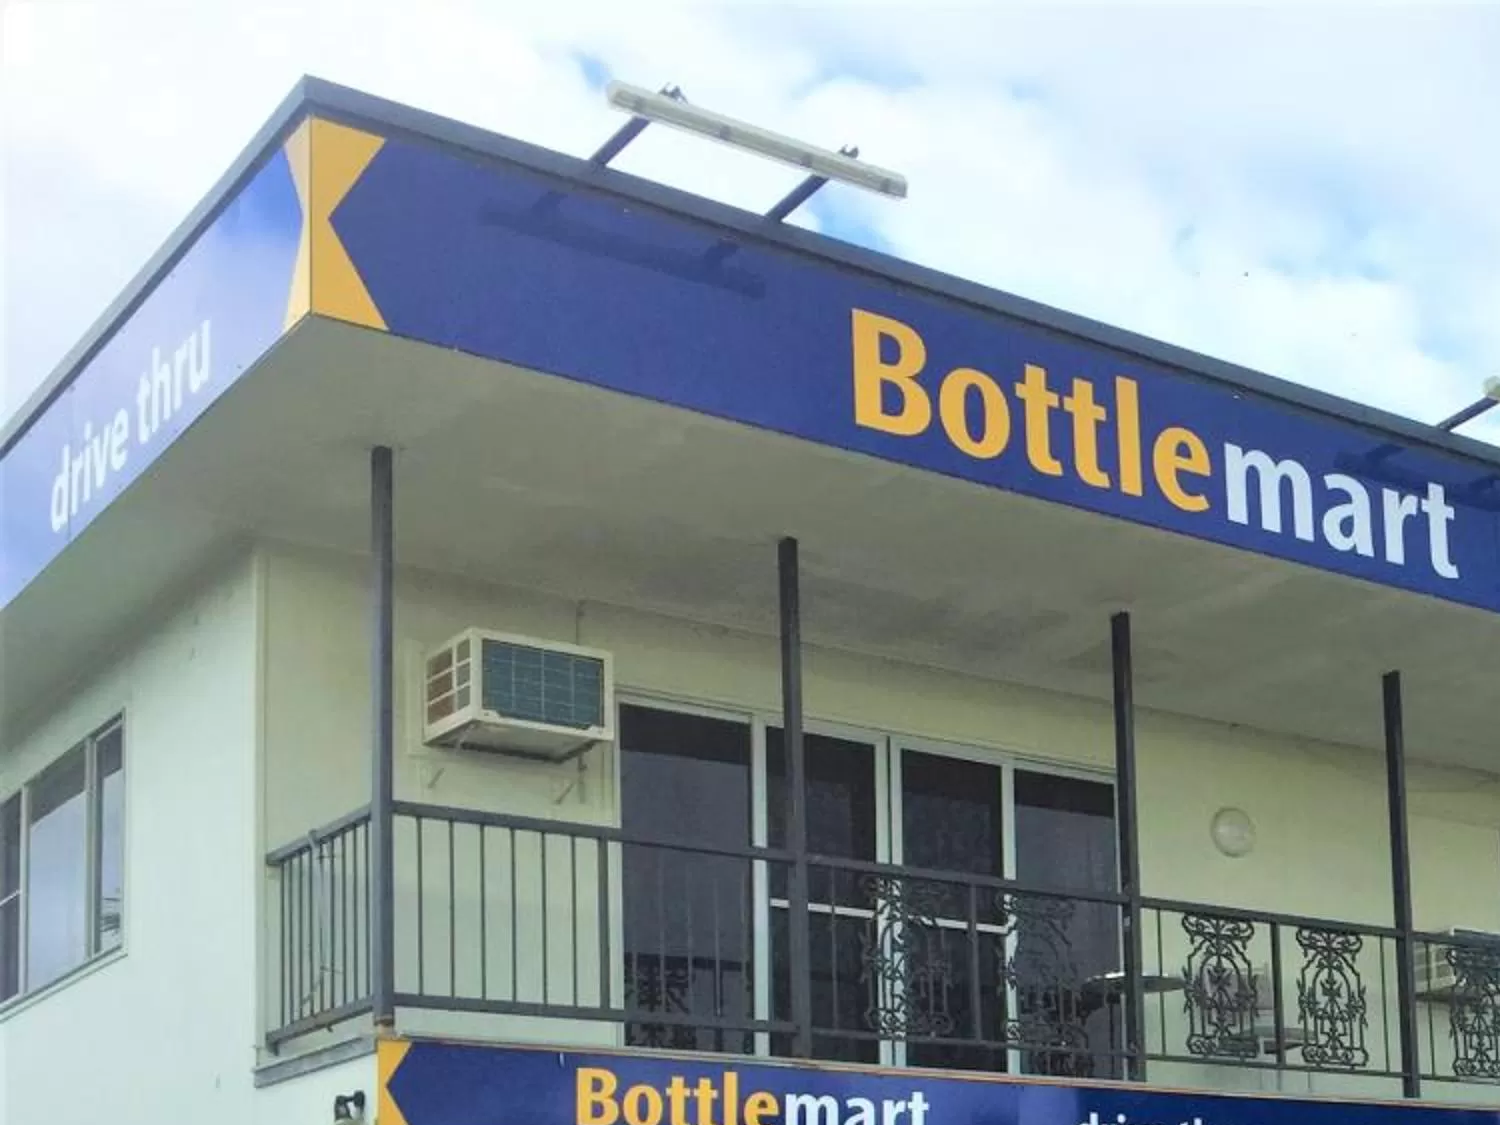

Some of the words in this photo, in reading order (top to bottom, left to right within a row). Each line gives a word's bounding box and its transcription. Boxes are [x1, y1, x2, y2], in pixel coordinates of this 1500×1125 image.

[51, 407, 129, 533] drive
[136, 319, 211, 445] thru
[850, 307, 1459, 580] Bottlemart
